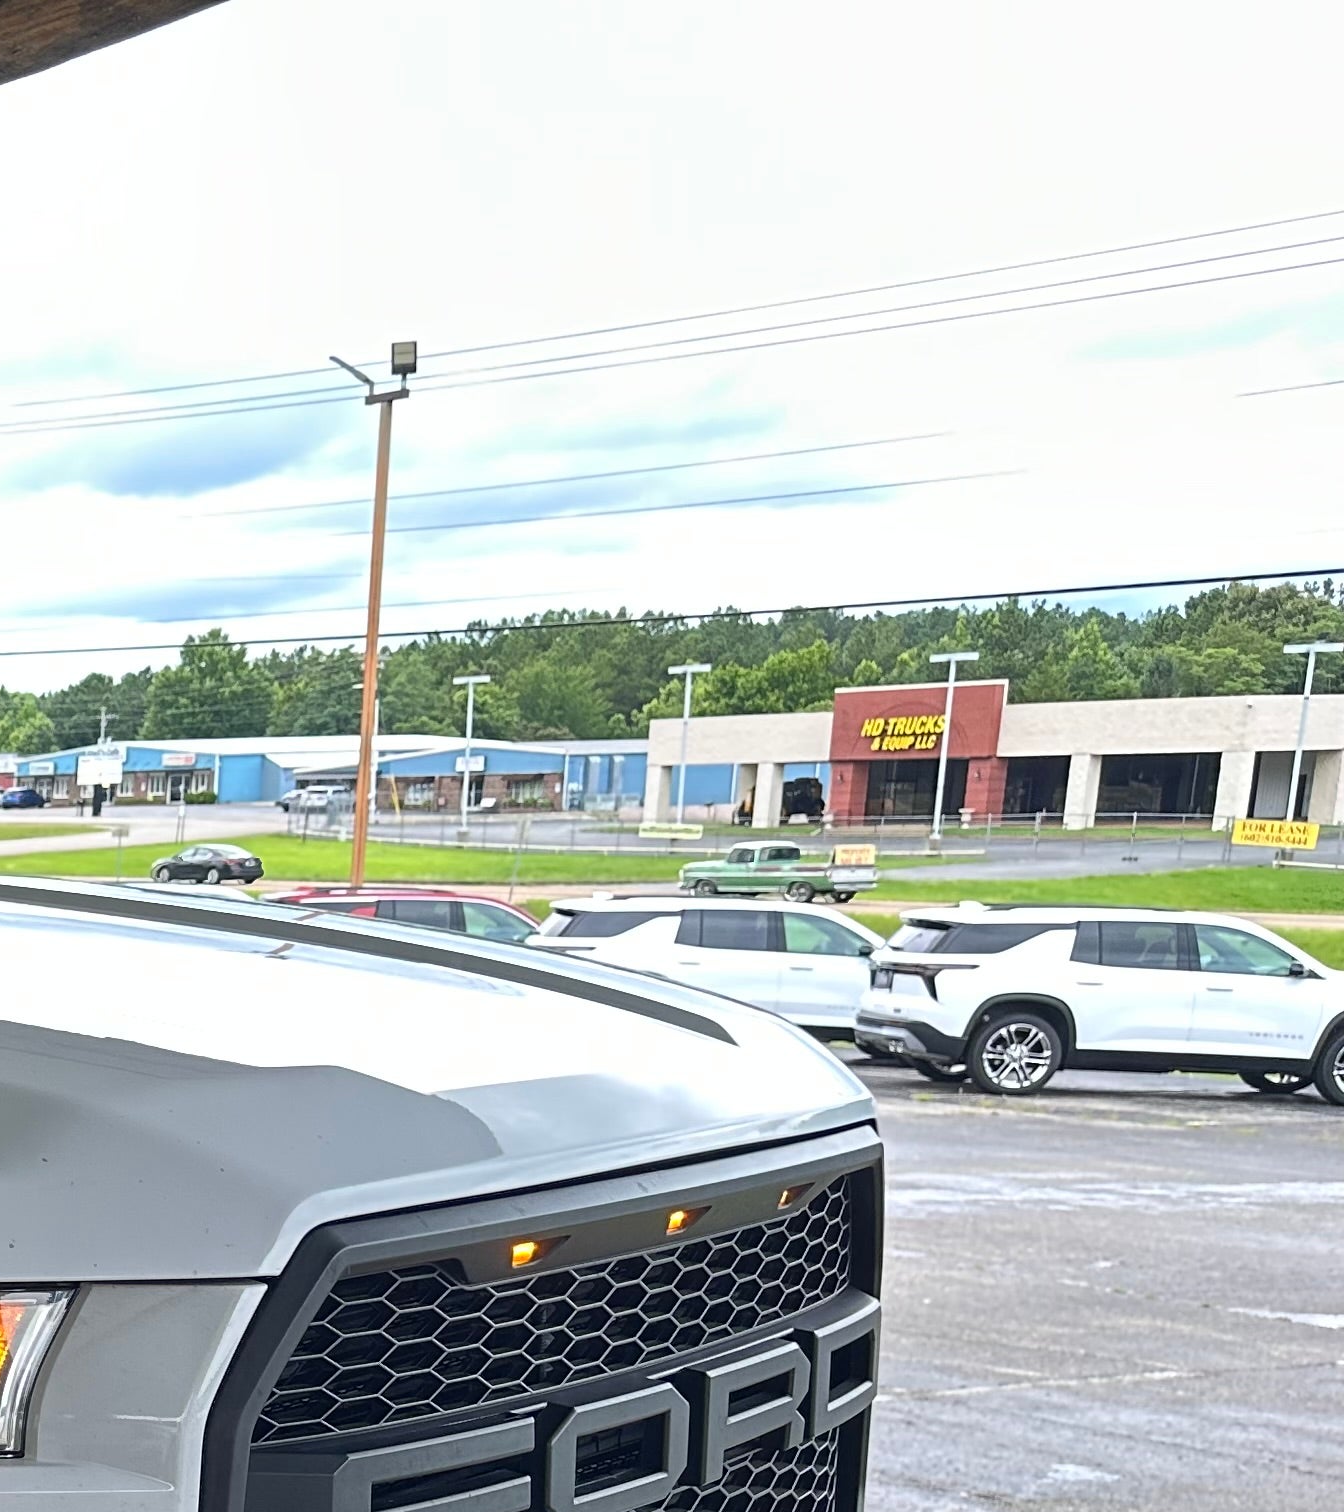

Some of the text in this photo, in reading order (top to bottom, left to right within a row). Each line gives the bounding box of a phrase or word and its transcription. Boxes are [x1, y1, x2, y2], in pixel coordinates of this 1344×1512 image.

[914, 735, 937, 750] LLC
[1241, 821, 1310, 836] FOR LEASE
